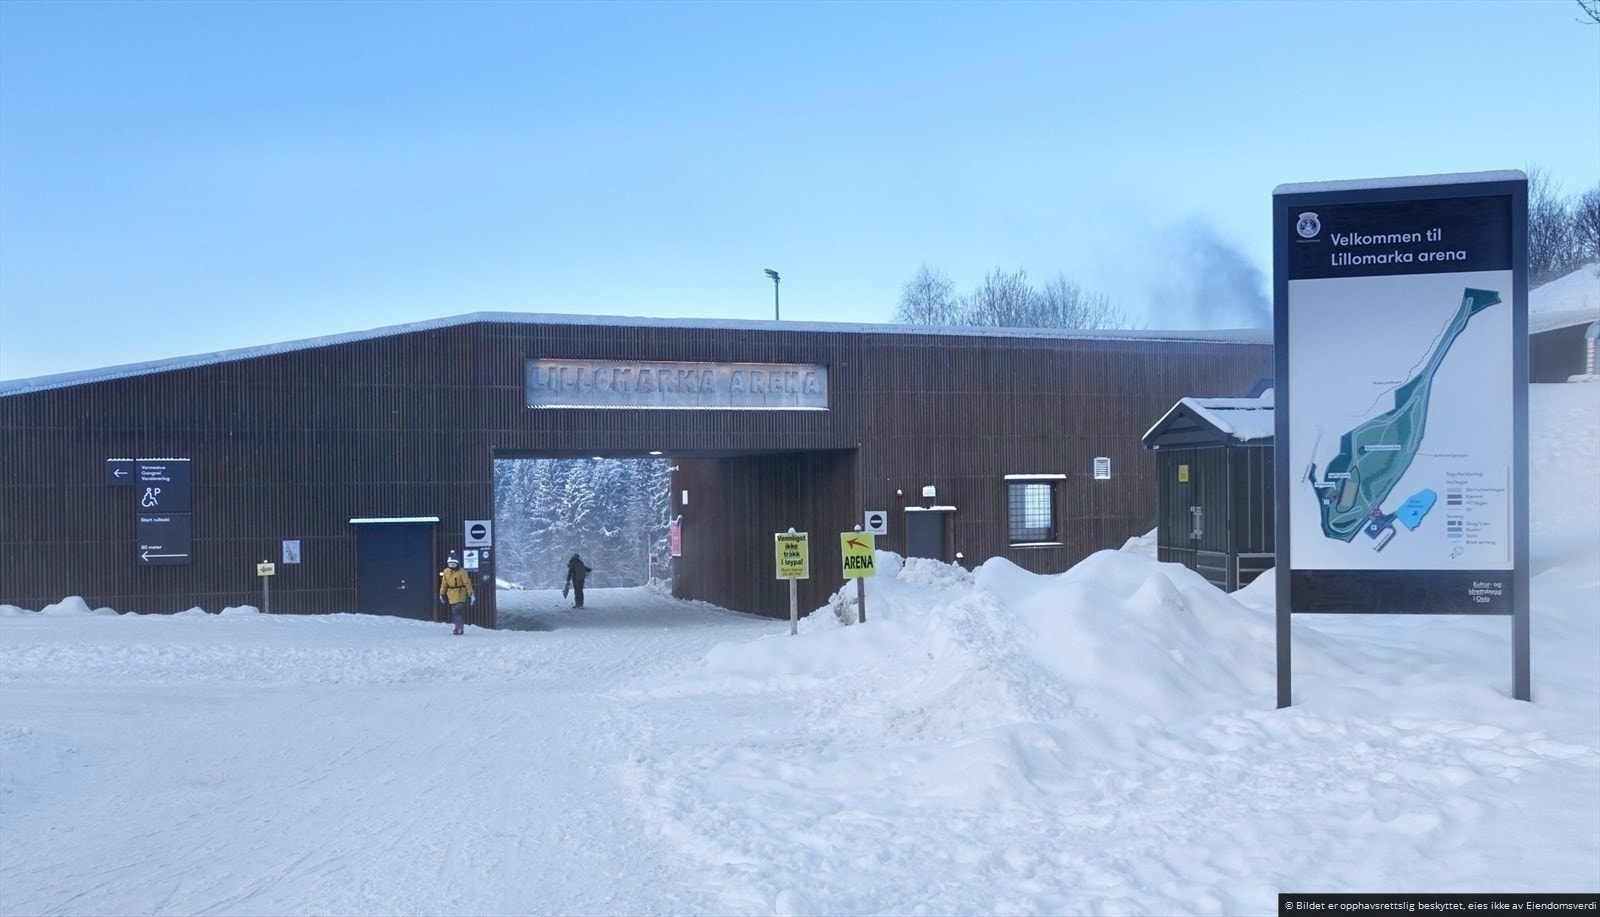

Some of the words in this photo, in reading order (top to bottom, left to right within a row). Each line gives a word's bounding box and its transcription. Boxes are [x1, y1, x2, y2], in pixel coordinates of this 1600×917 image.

[1330, 231, 1422, 247] Velkommen
[1426, 228, 1442, 242] til
[1330, 250, 1413, 266] Lillomarka
[1418, 250, 1467, 262] arena
[529, 366, 718, 395] LILLOMARKA
[729, 370, 821, 396] ARENA
[154, 488, 161, 496] P
[844, 555, 874, 570] ARENA
